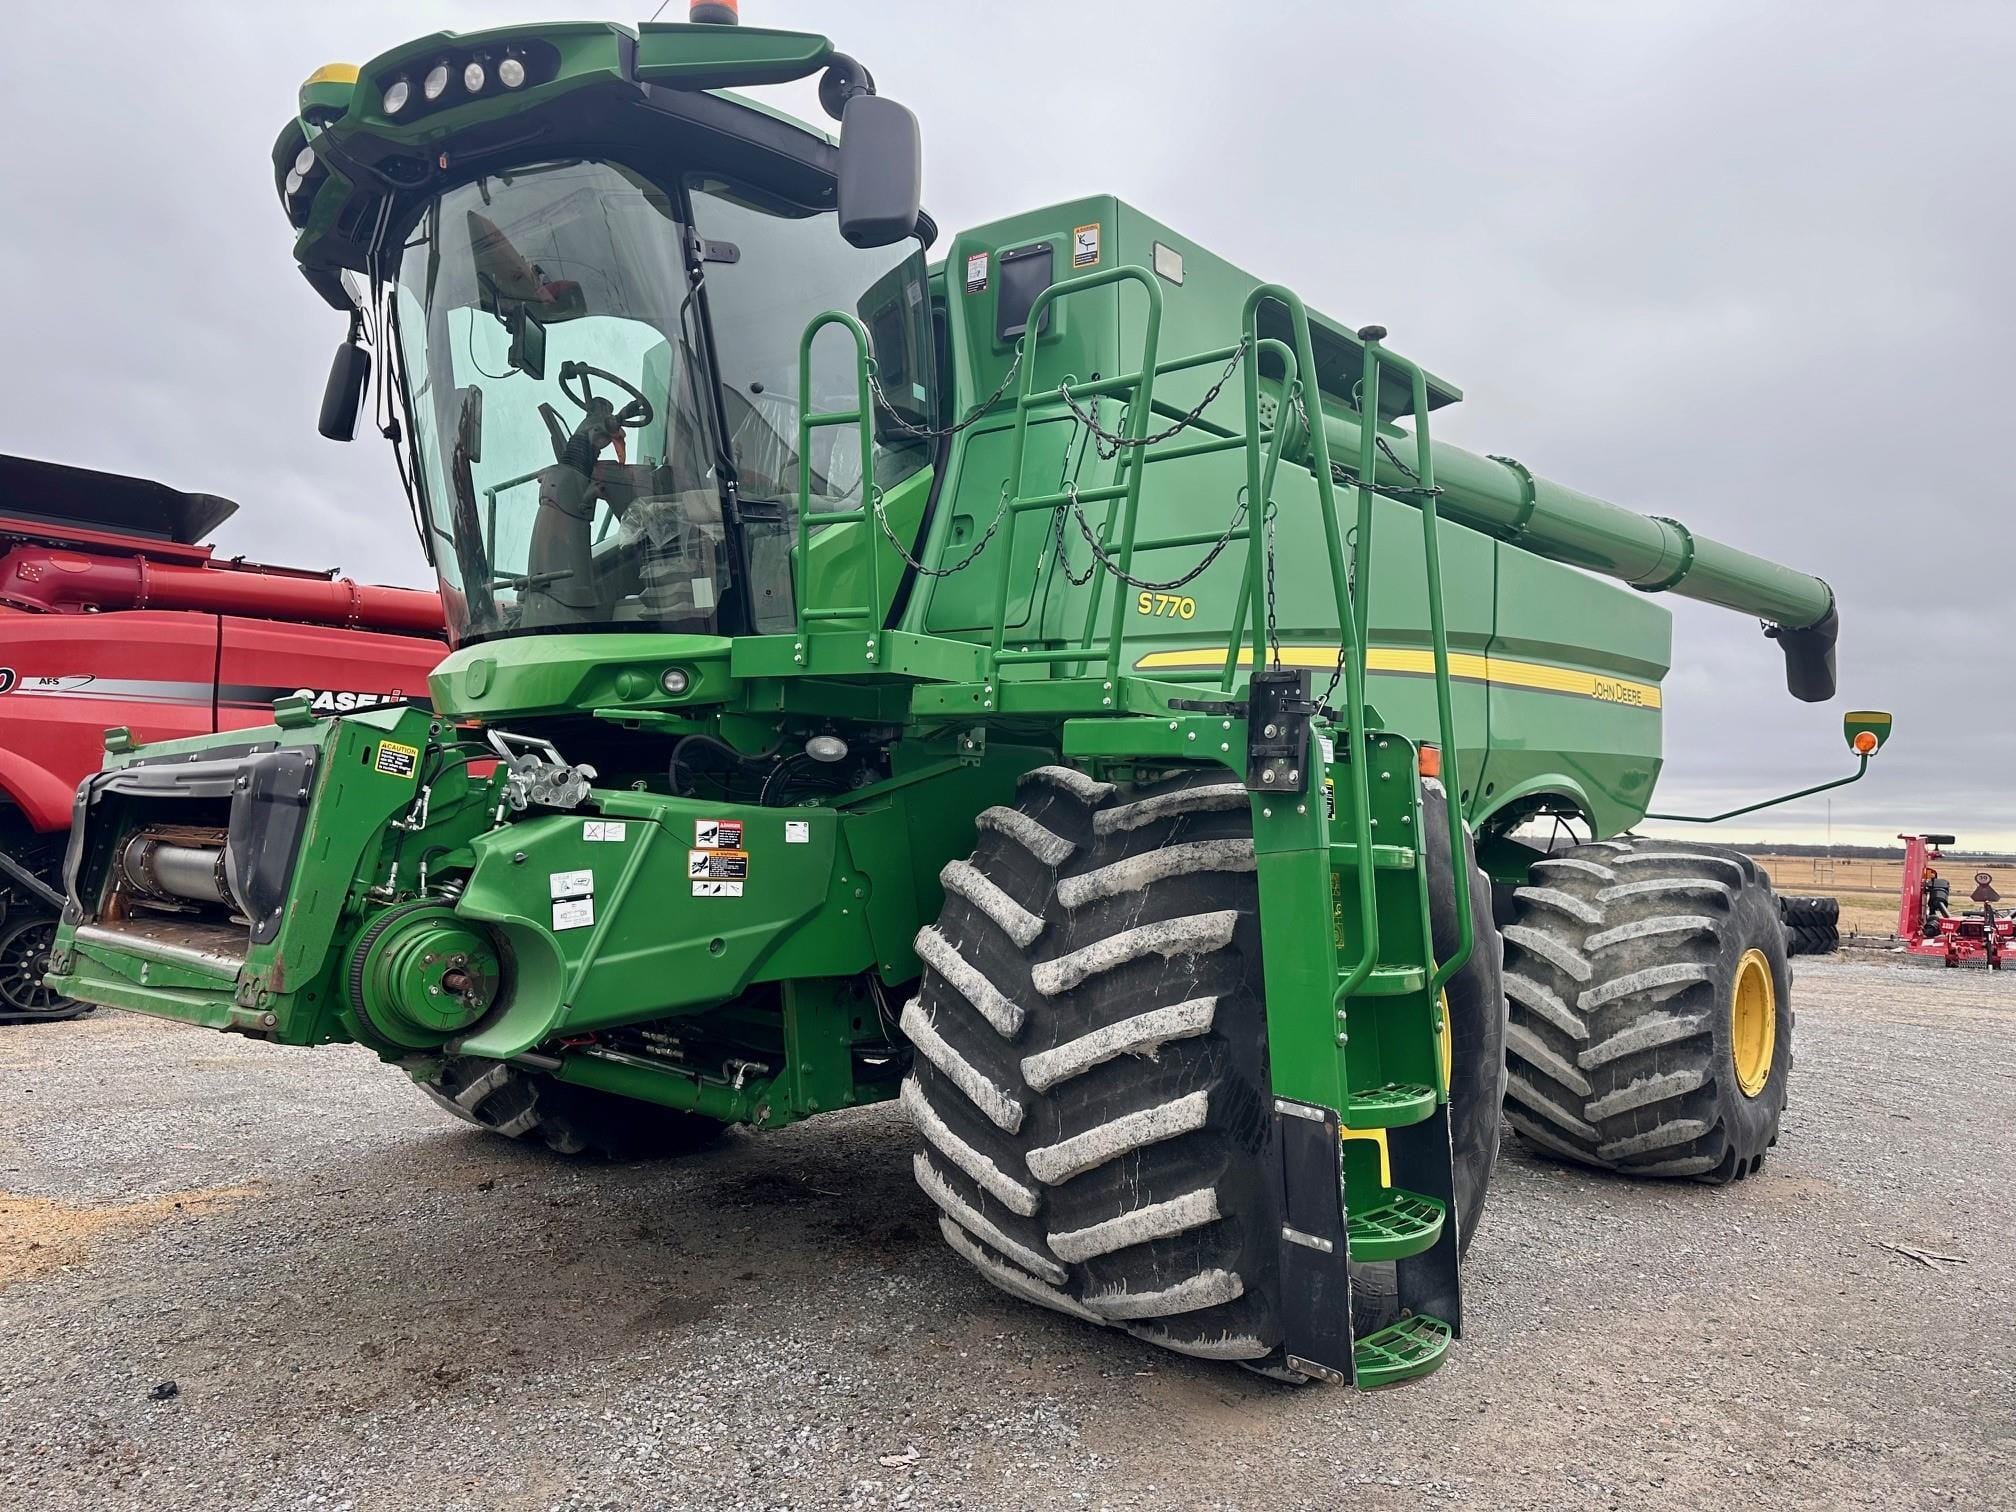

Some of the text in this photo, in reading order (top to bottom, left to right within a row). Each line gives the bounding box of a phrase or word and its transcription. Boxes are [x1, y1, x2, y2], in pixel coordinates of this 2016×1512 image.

[1138, 591, 1196, 620] S770
[39, 677, 60, 686] AFS
[1592, 678, 1642, 704] JOHN DEERE
[387, 743, 417, 755] CAUTION
